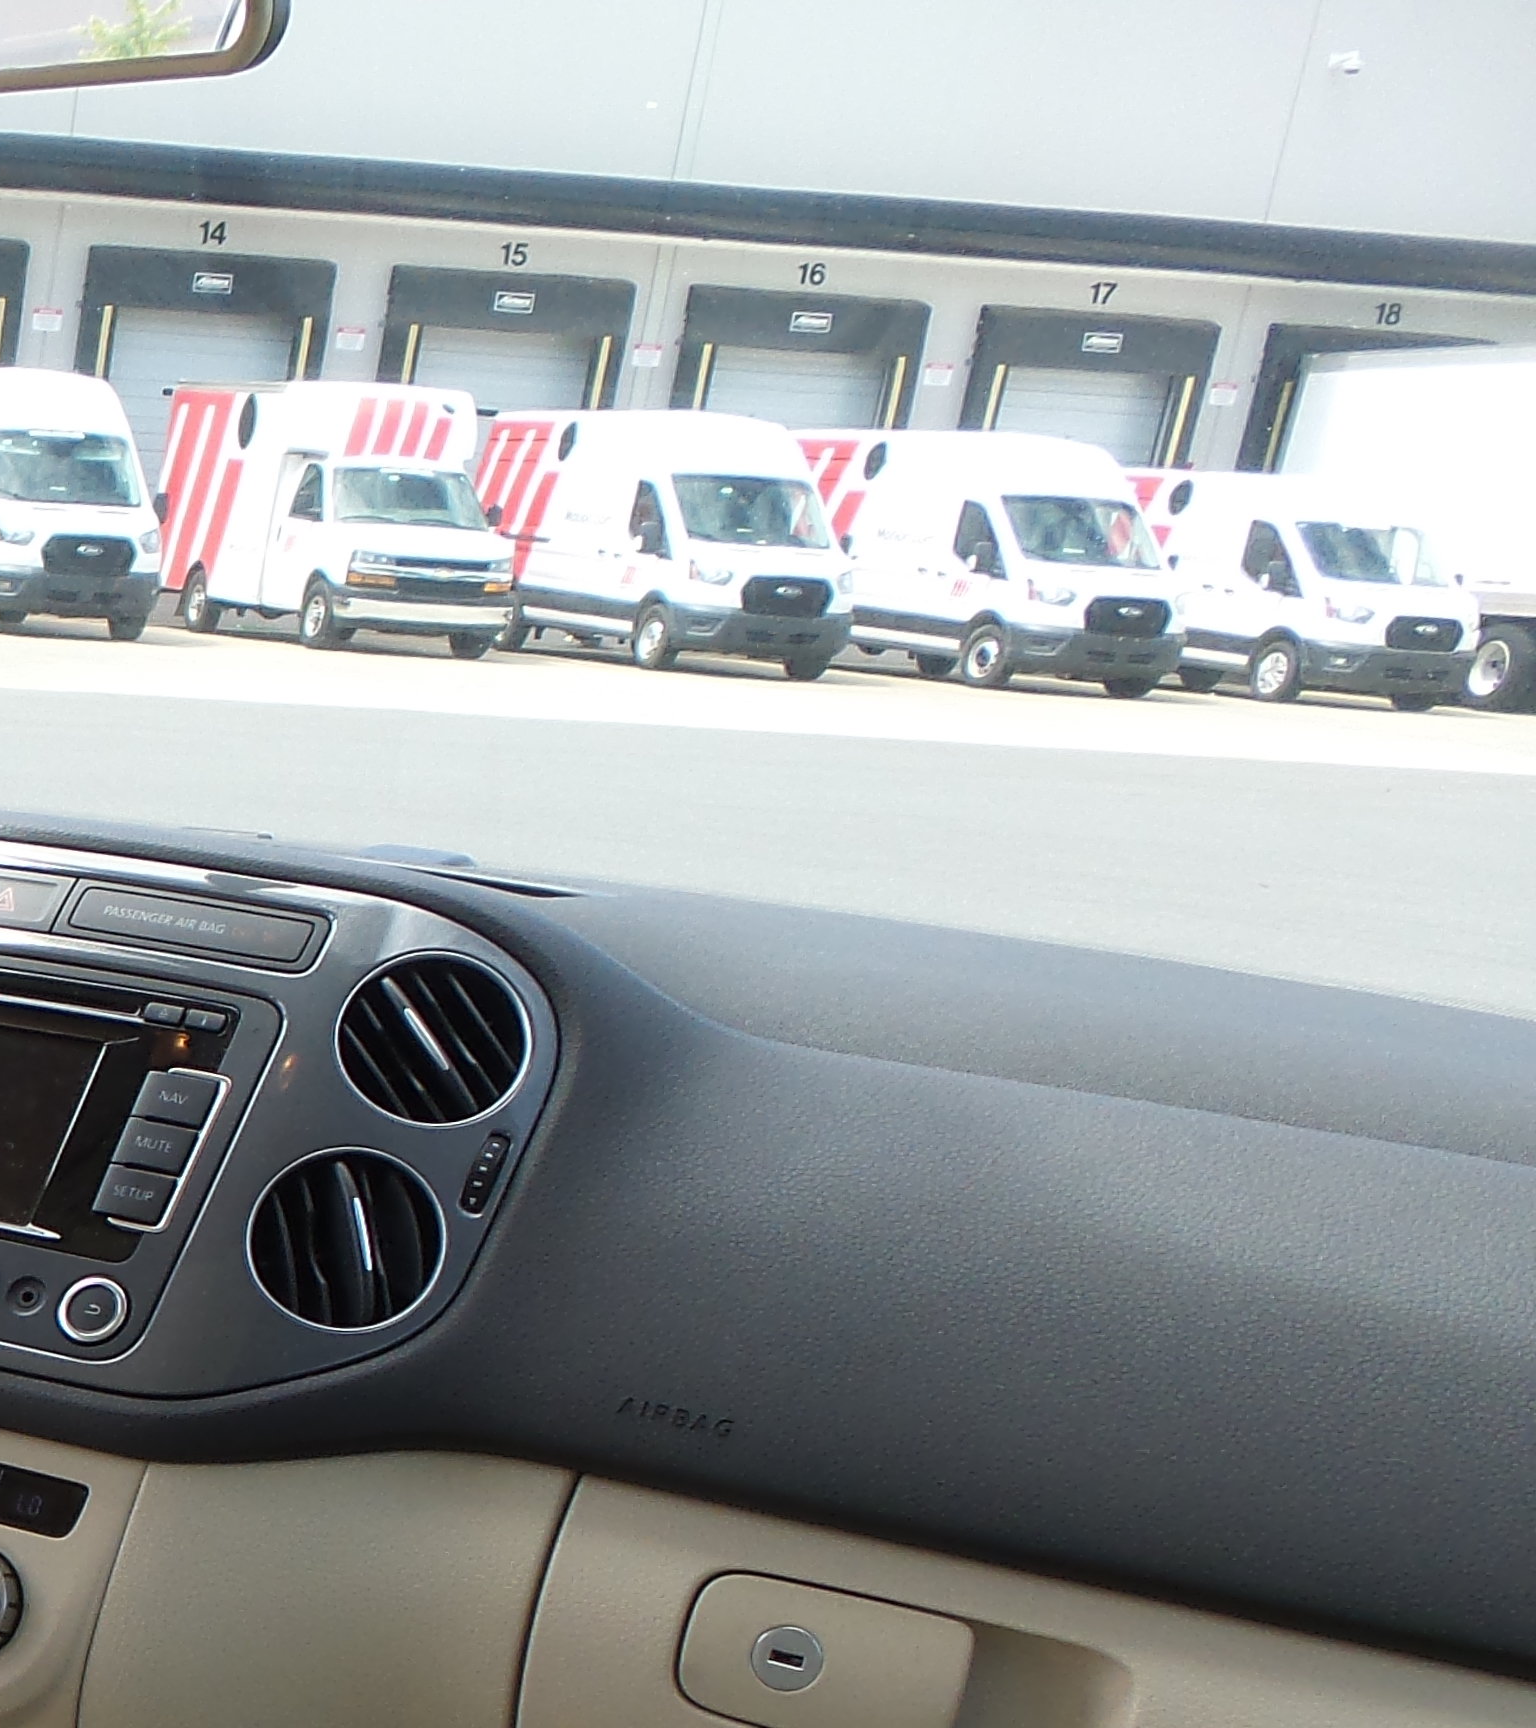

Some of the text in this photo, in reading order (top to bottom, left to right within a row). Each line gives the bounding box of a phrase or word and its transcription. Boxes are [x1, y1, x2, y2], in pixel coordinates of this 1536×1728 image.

[198, 220, 227, 245] 14
[500, 242, 528, 266] 15
[798, 263, 826, 285] 16
[1090, 282, 1118, 304] 17
[1375, 302, 1402, 325] 18
[103, 905, 174, 926] PASSENGER
[174, 916, 197, 930] AIR
[198, 919, 226, 934] BAG
[159, 1090, 188, 1104] NAV
[135, 1135, 172, 1153] MUTE
[113, 1185, 154, 1200] SETUP
[616, 1397, 735, 1438] AIRBAG
